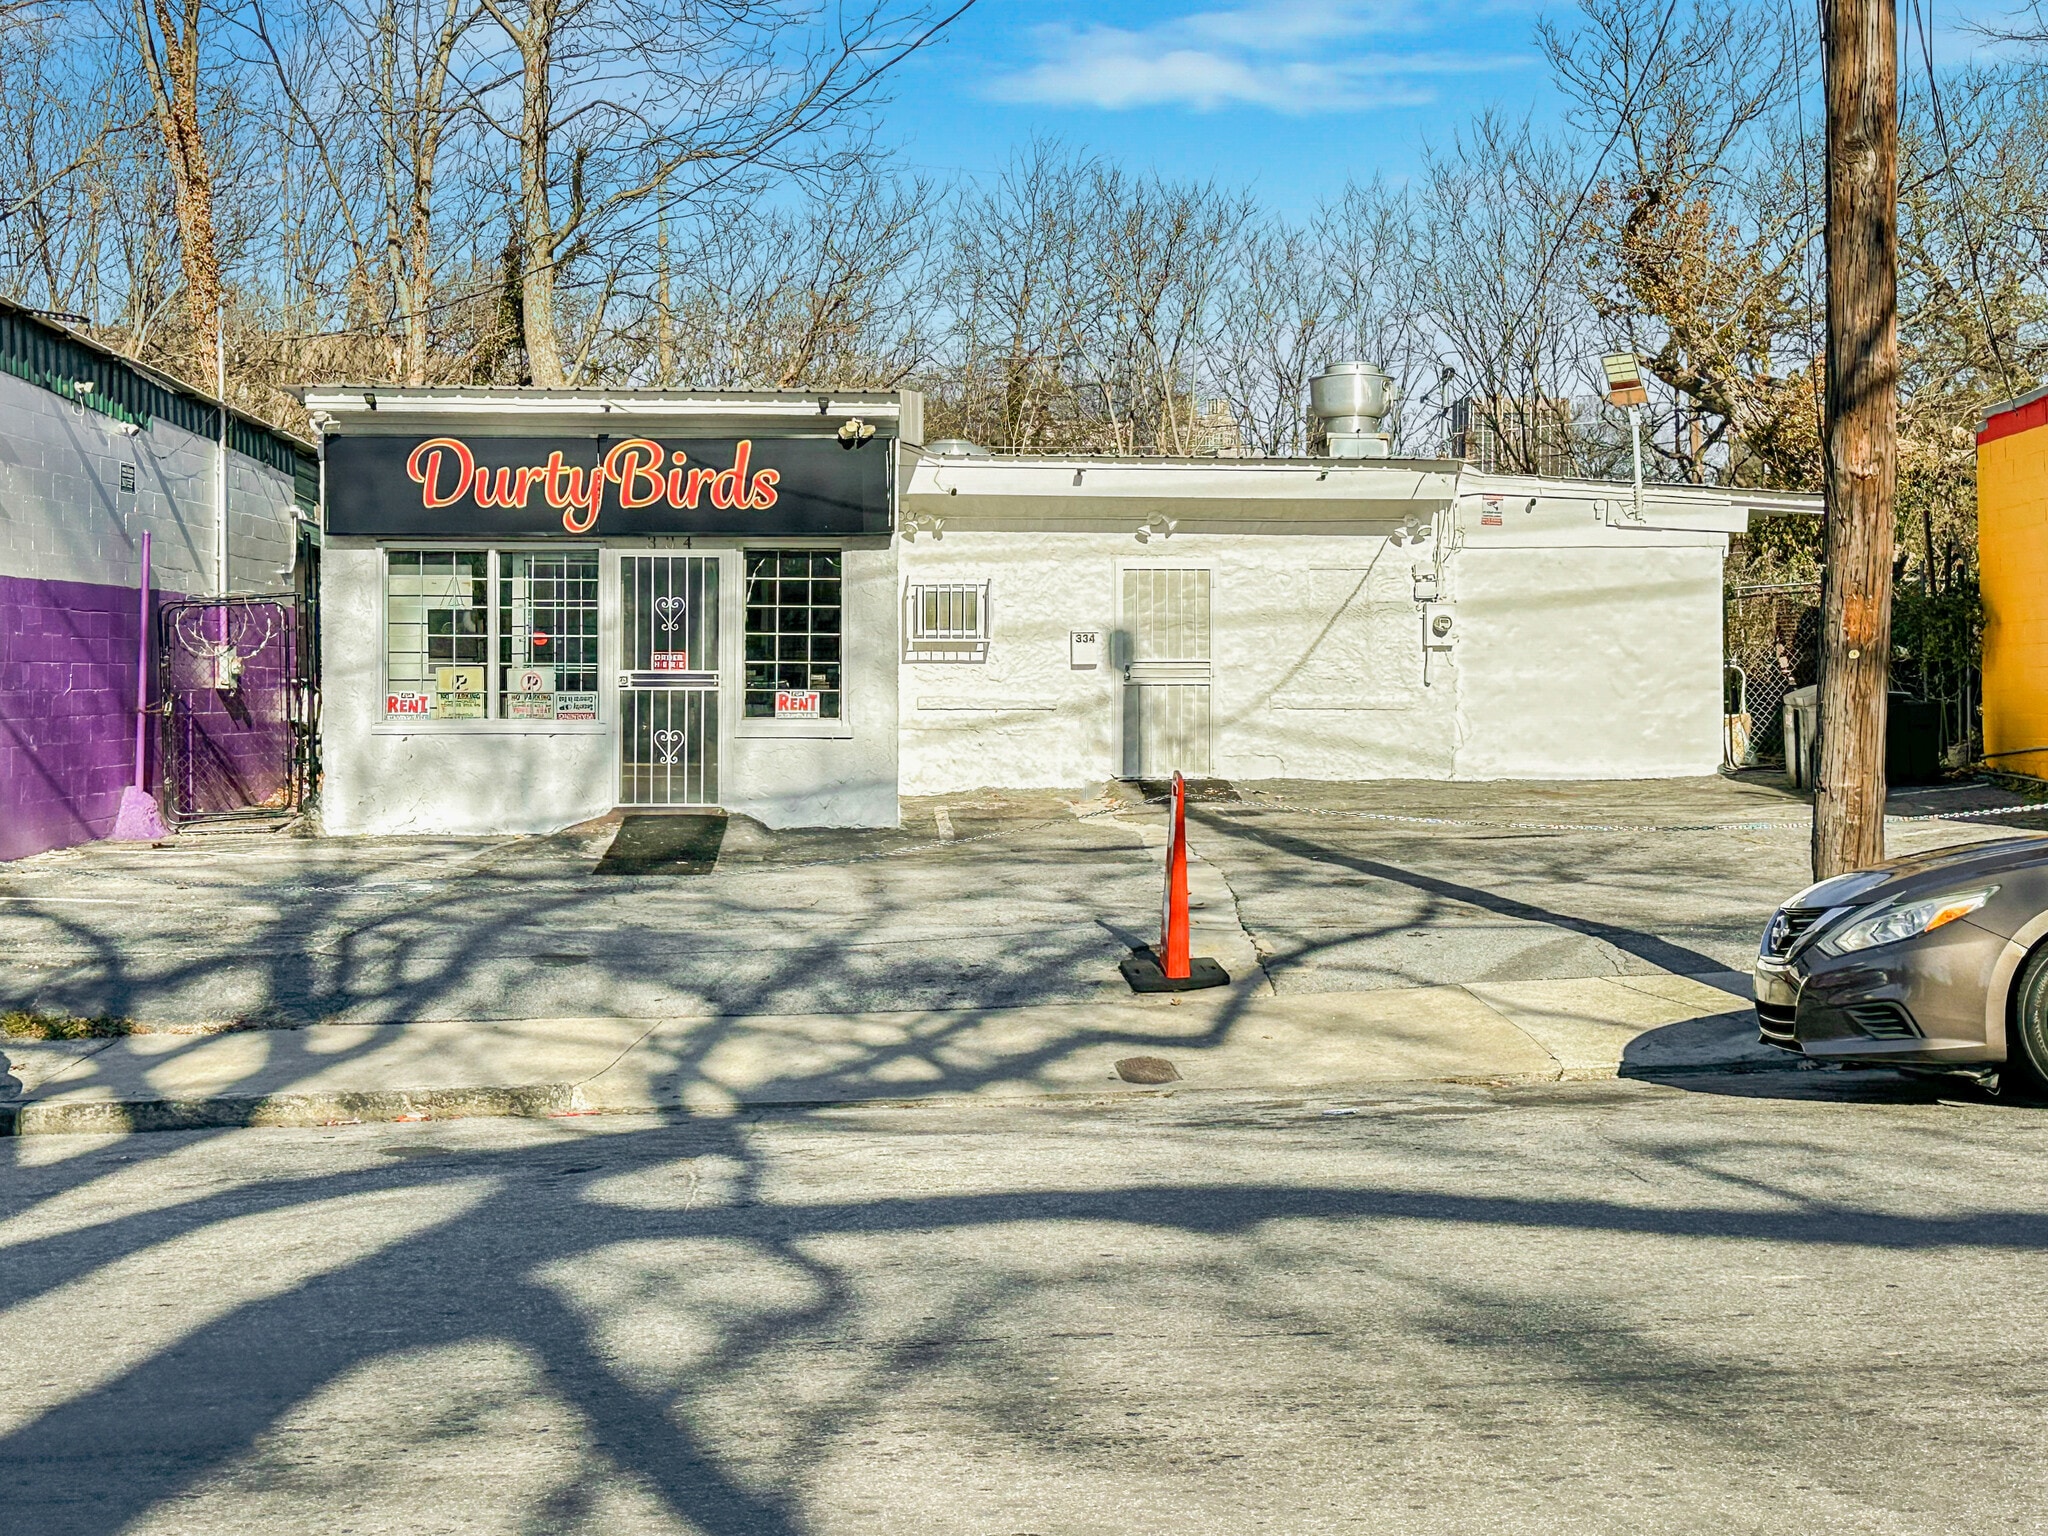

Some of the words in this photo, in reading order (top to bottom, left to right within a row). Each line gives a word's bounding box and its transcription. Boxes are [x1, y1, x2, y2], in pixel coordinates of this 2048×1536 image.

[406, 437, 604, 533] Durty
[603, 438, 781, 510] Birds
[1075, 634, 1095, 643] 334
[387, 695, 428, 713] RENT
[778, 693, 817, 711] RENT
